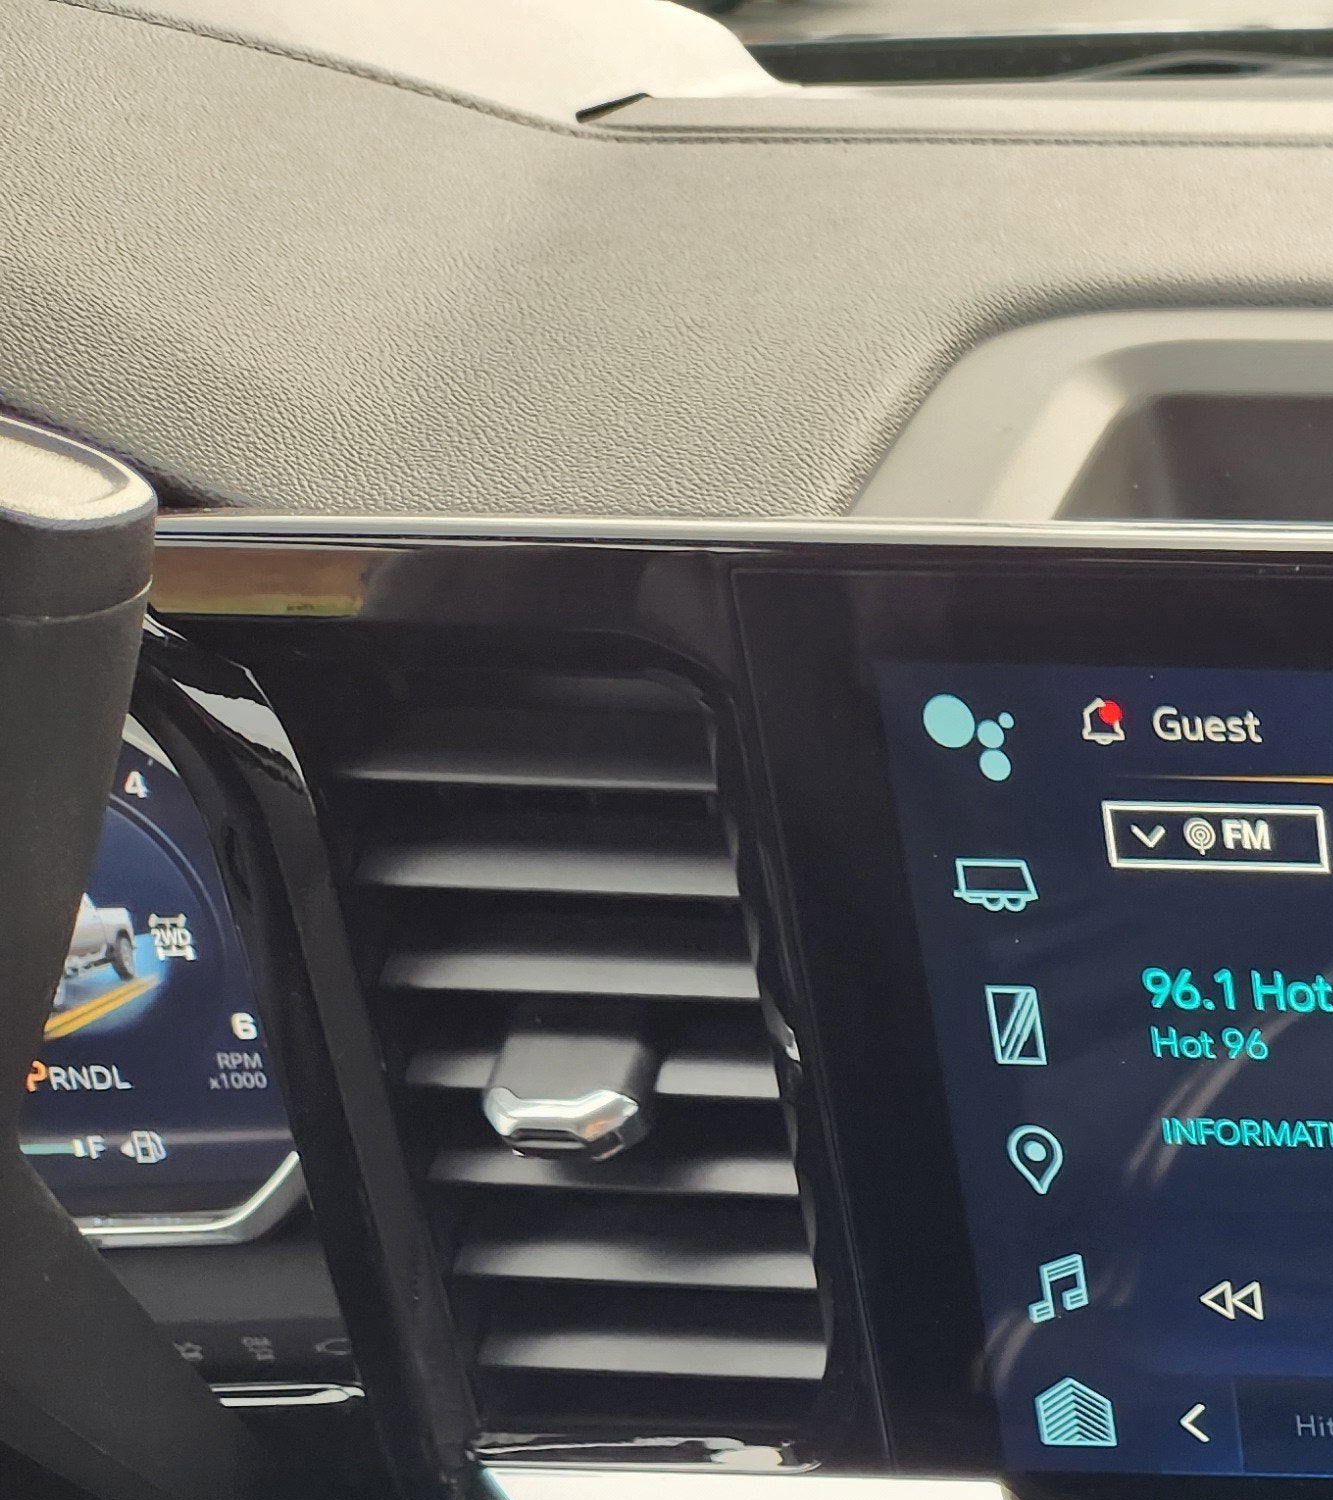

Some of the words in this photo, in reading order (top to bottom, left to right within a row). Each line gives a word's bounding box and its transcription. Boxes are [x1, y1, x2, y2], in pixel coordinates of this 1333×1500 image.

[1152, 706, 1263, 744] Guest
[124, 771, 149, 798] 4
[1222, 820, 1271, 851] FM
[151, 928, 191, 948] 2WD
[1142, 967, 1236, 1012] 96.1
[1251, 970, 1333, 1014] Hot
[231, 1012, 258, 1040] 6
[1151, 1027, 1217, 1060] Hot
[1223, 1029, 1268, 1060] 96
[216, 1052, 263, 1070] RPM
[209, 1071, 268, 1090] x1000
